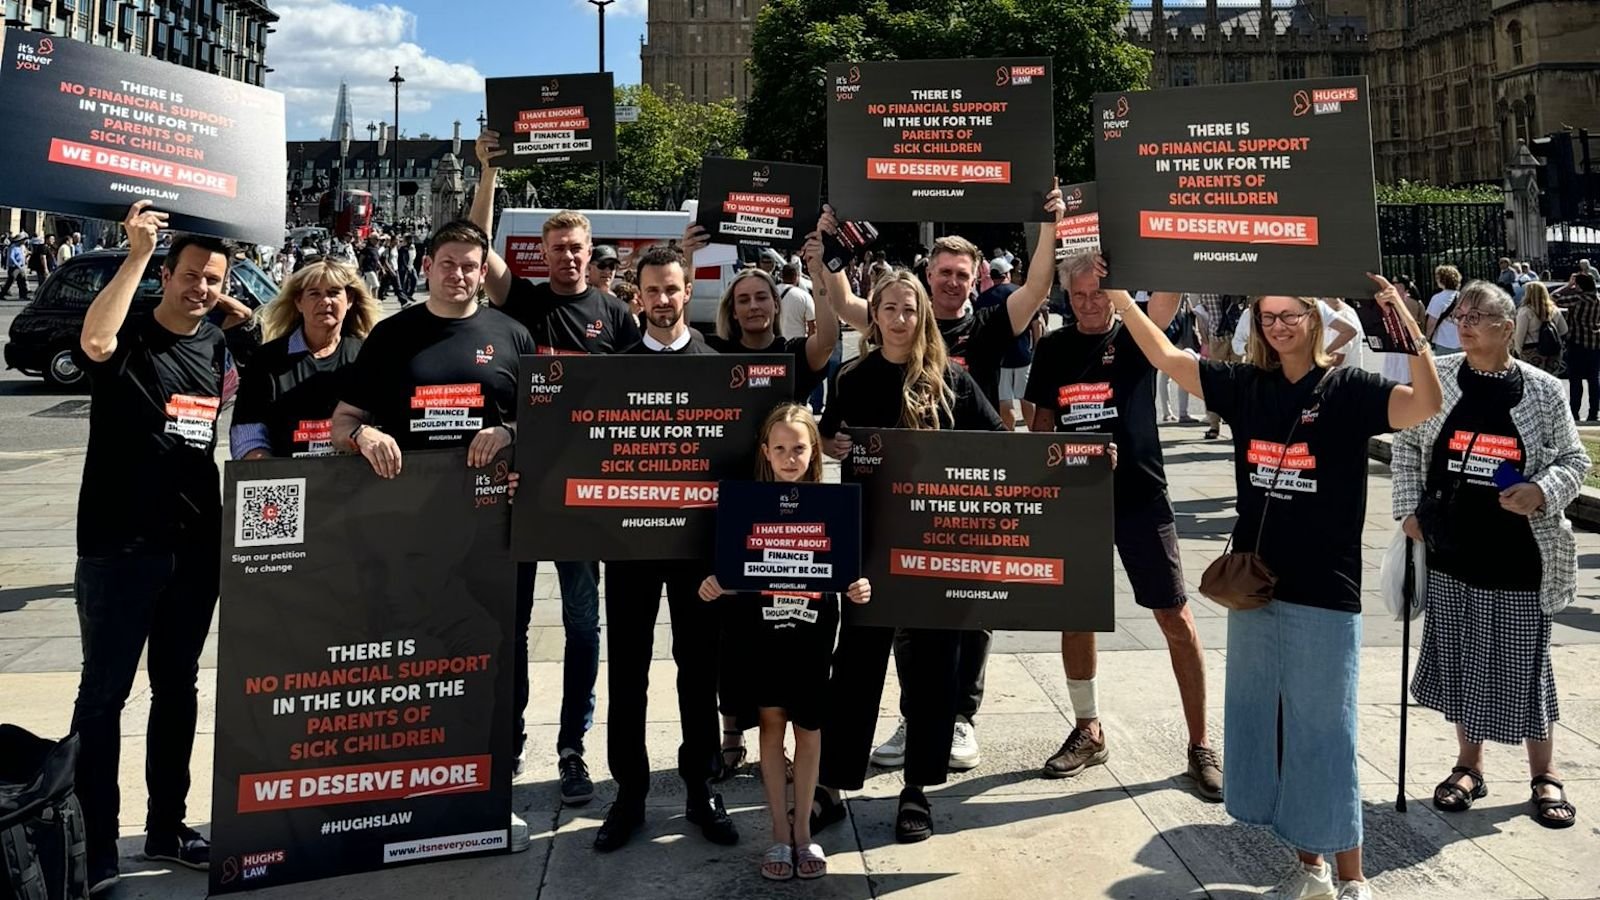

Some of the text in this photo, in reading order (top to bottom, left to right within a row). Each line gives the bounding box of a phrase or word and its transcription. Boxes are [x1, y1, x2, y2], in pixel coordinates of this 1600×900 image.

[19, 43, 34, 53] it's
[16, 61, 40, 70] you
[18, 53, 52, 65] never
[120, 80, 183, 103] THERE IS
[911, 89, 962, 100] THERE IS
[1315, 90, 1356, 99] HUGH'S
[59, 82, 235, 128] NO FINANCIAL SUPPORT
[868, 102, 1008, 114] NO FINANCIAL SUPPORT
[1316, 103, 1339, 112] LAW
[79, 99, 218, 136] IN THE UK FOR THE
[548, 109, 580, 117] ENOUGH
[1103, 109, 1114, 119] it's
[883, 116, 992, 127] IN THE UK FOR THE
[1103, 119, 1129, 129] never
[104, 118, 194, 144] PARENTS OF
[902, 130, 973, 139] PARENTS OF
[1104, 129, 1121, 140] you
[1188, 123, 1250, 137] THERE IS
[90, 129, 204, 160] SICK CHILDREN
[518, 143, 559, 151] SHOULDN'T
[894, 143, 982, 153] SICK CHILDREN
[1138, 138, 1309, 155] NO FINANCIAL SUPPORT
[62, 145, 227, 189] WE DESERVE MORE
[876, 163, 1002, 177] WE DESERVE MORE
[1156, 156, 1290, 172] IN THE UK FOR THE
[1179, 175, 1265, 188] PARENTS OF
[110, 182, 179, 200] #HUGHSLAW
[1169, 192, 1278, 205] SICK CHILDREN
[740, 216, 774, 224] FINANCES
[1150, 217, 1307, 238] WE DESERVE MORE
[1193, 252, 1258, 262] #HUGHSLAW
[750, 367, 784, 375] HUGH'S
[532, 374, 545, 383] it's
[750, 377, 769, 385] LAW
[531, 384, 562, 394] never
[531, 394, 552, 405] you
[628, 393, 689, 405] THERE IS
[571, 409, 742, 422] NO FINANCIAL SUPPORT
[590, 425, 723, 438] IN THE UK FOR THE
[613, 442, 699, 455] PARENTS OF
[601, 459, 709, 472] SICK CHILDREN
[945, 468, 1006, 480] THERE IS
[577, 485, 602, 499] WE
[607, 486, 679, 500] DESERVE
[893, 483, 1061, 498] NO FINANCIAL SUPPORT
[911, 500, 1042, 514] IN THE UK FOR THE
[622, 518, 686, 527] #HUGHSLAW
[934, 517, 1019, 530] PARENTS OF
[751, 538, 762, 546] TO
[923, 533, 1030, 547] SICK CHILDREN
[232, 554, 252, 563] Sign
[271, 551, 306, 562] petition
[768, 552, 808, 560] FINANCES
[245, 563, 292, 574] for change
[901, 555, 1053, 577] WE DESERVE MORE
[946, 590, 1008, 600] #HUGHSLAW
[328, 640, 415, 662] THERE IS
[246, 654, 490, 693] NO FINANCIAL SUPPORT
[273, 680, 464, 715] IN THE UK FOR THE
[307, 706, 430, 734] PARENTS OF
[290, 728, 445, 760] SICK CHILDREN
[255, 764, 477, 801] WE DESERVE MORE
[321, 812, 412, 834] #HUGHSLAW
[389, 835, 503, 857] www.itsneveryou.com
